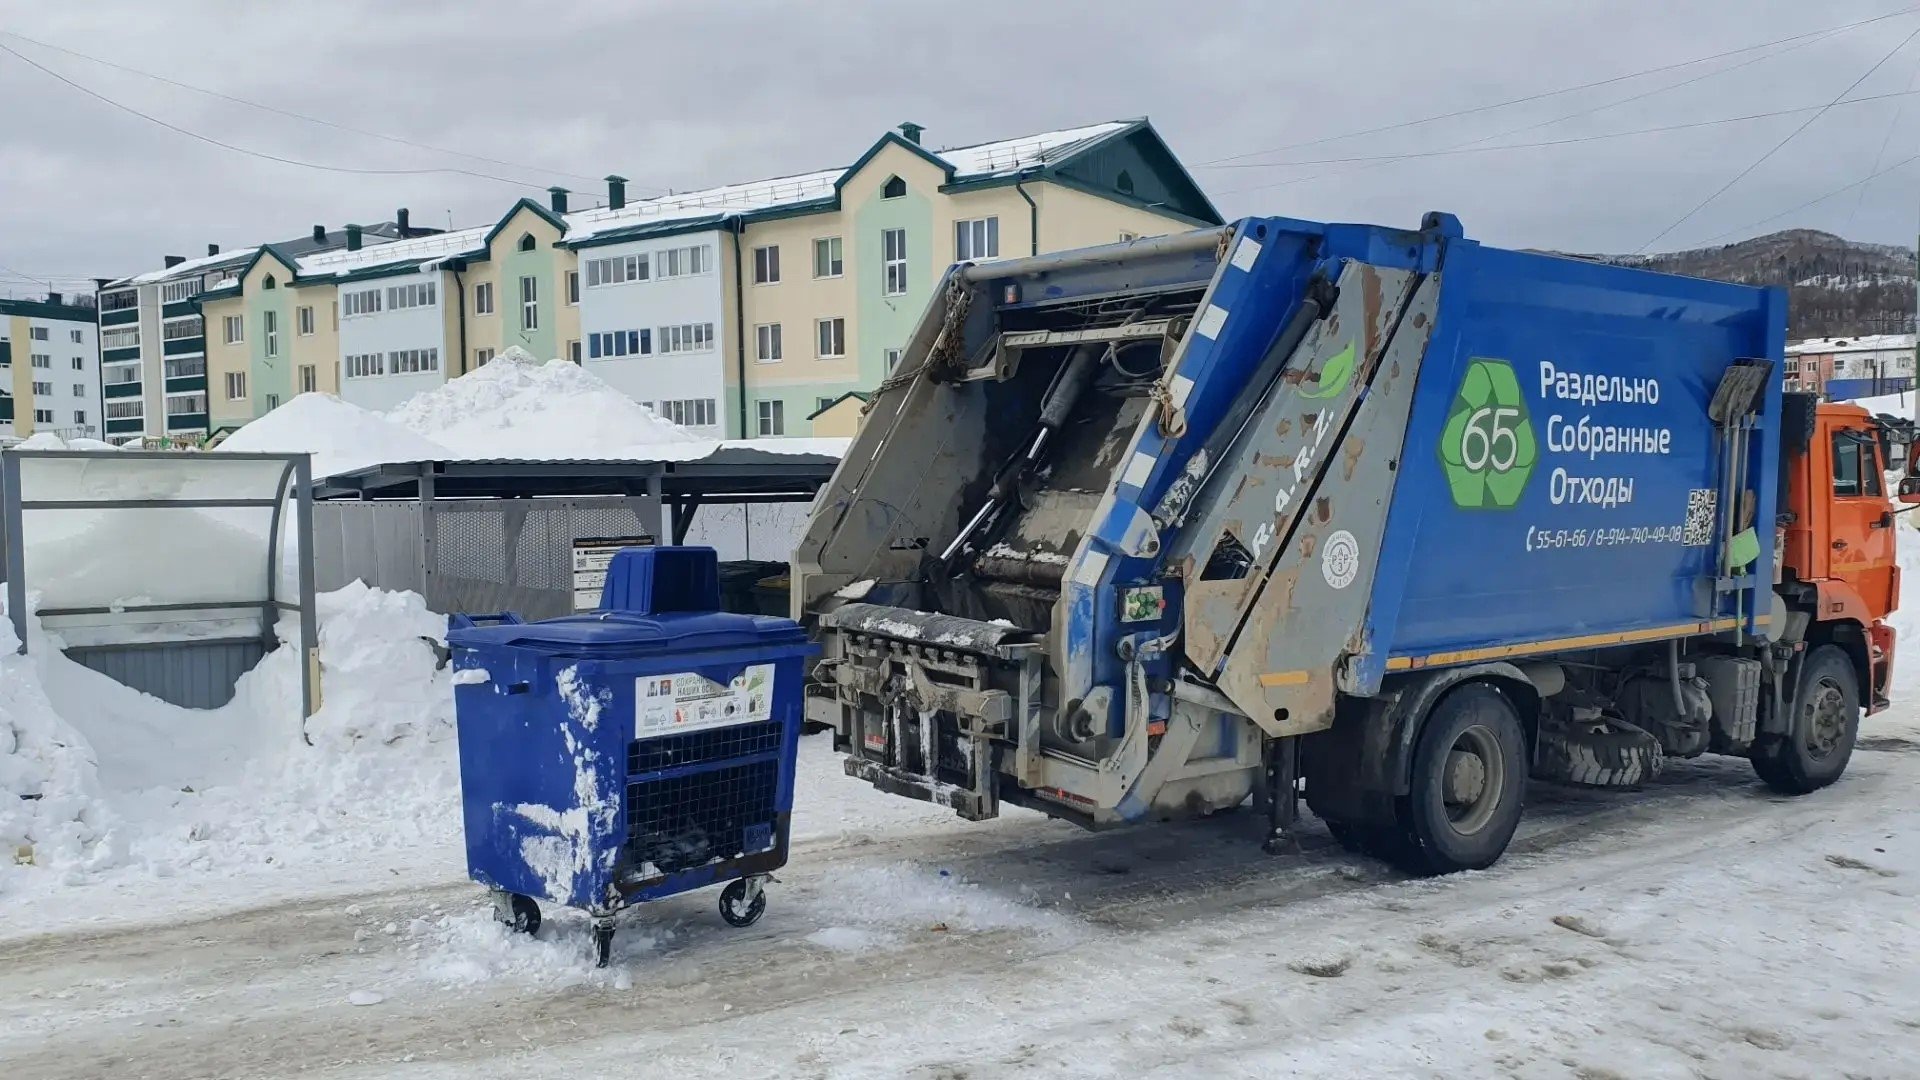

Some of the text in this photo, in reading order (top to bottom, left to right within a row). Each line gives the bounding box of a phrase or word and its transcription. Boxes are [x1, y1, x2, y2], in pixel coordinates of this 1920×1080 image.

[1540, 361, 1659, 407] Раздельно
[1462, 408, 1518, 471] 65
[1547, 414, 1671, 461] Собранные
[1550, 467, 1633, 509] Отходы
[1536, 529, 1587, 549] 55-61-66
[1595, 525, 1682, 547] 8-914-740-49-08
